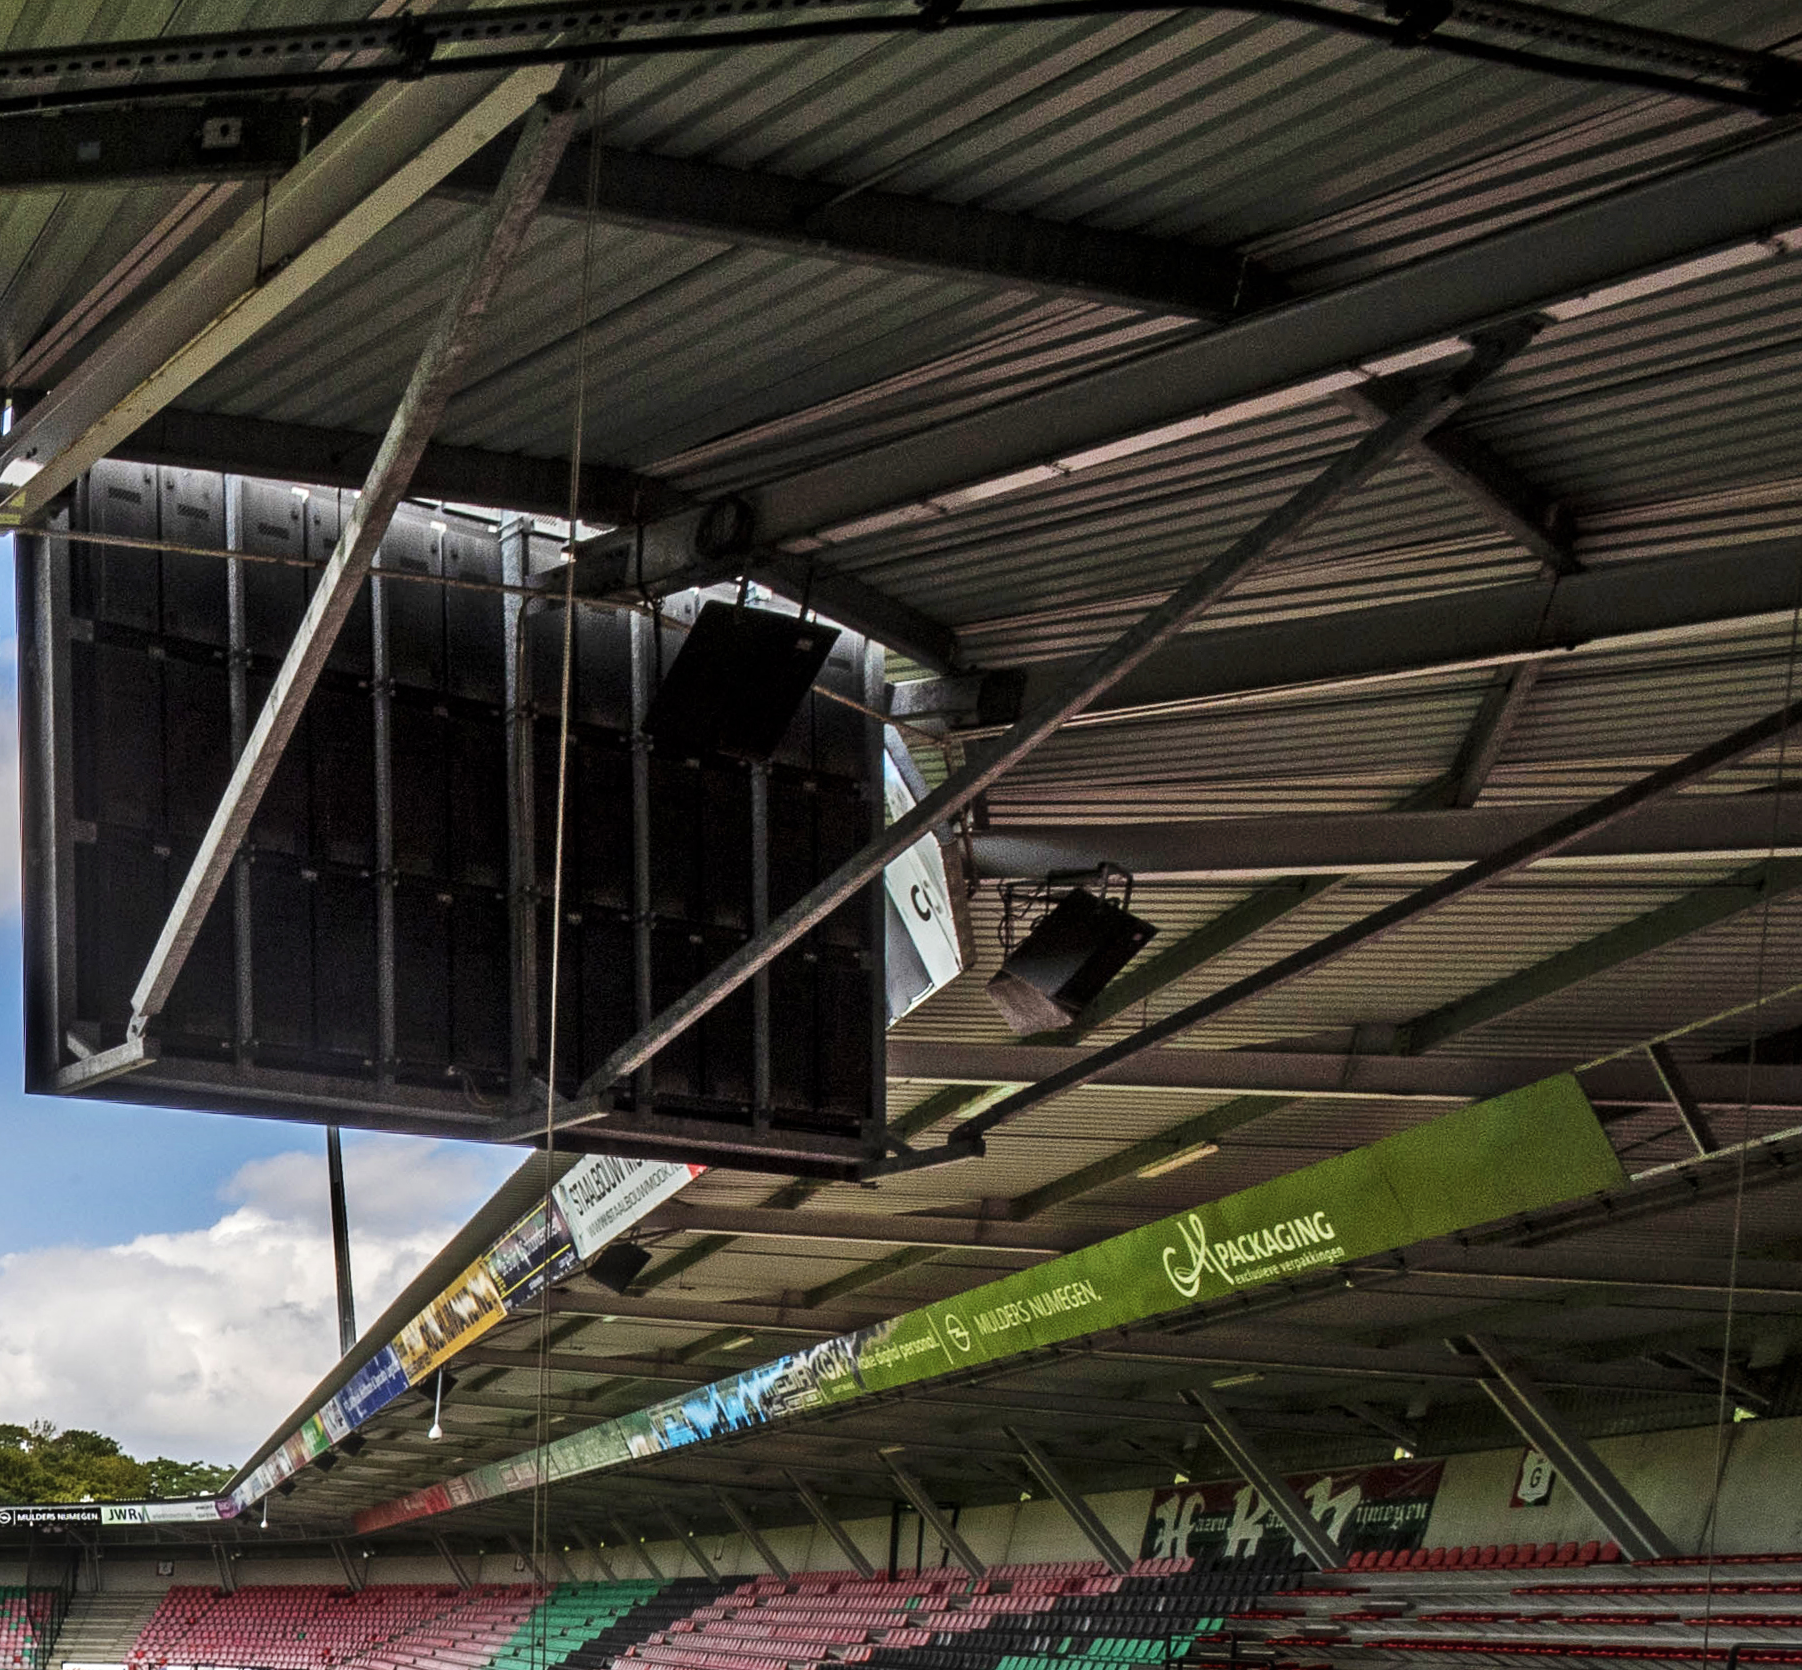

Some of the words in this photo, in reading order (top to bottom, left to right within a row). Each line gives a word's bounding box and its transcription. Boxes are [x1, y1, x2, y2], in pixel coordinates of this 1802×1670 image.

[1214, 1211, 1336, 1269] PACKAGING
[1234, 1264, 1280, 1285] exclusieve
[1280, 1246, 1346, 1273] verpakkingen
[973, 1302, 1032, 1336] MULDERS
[17, 1511, 56, 1522] MULDERS
